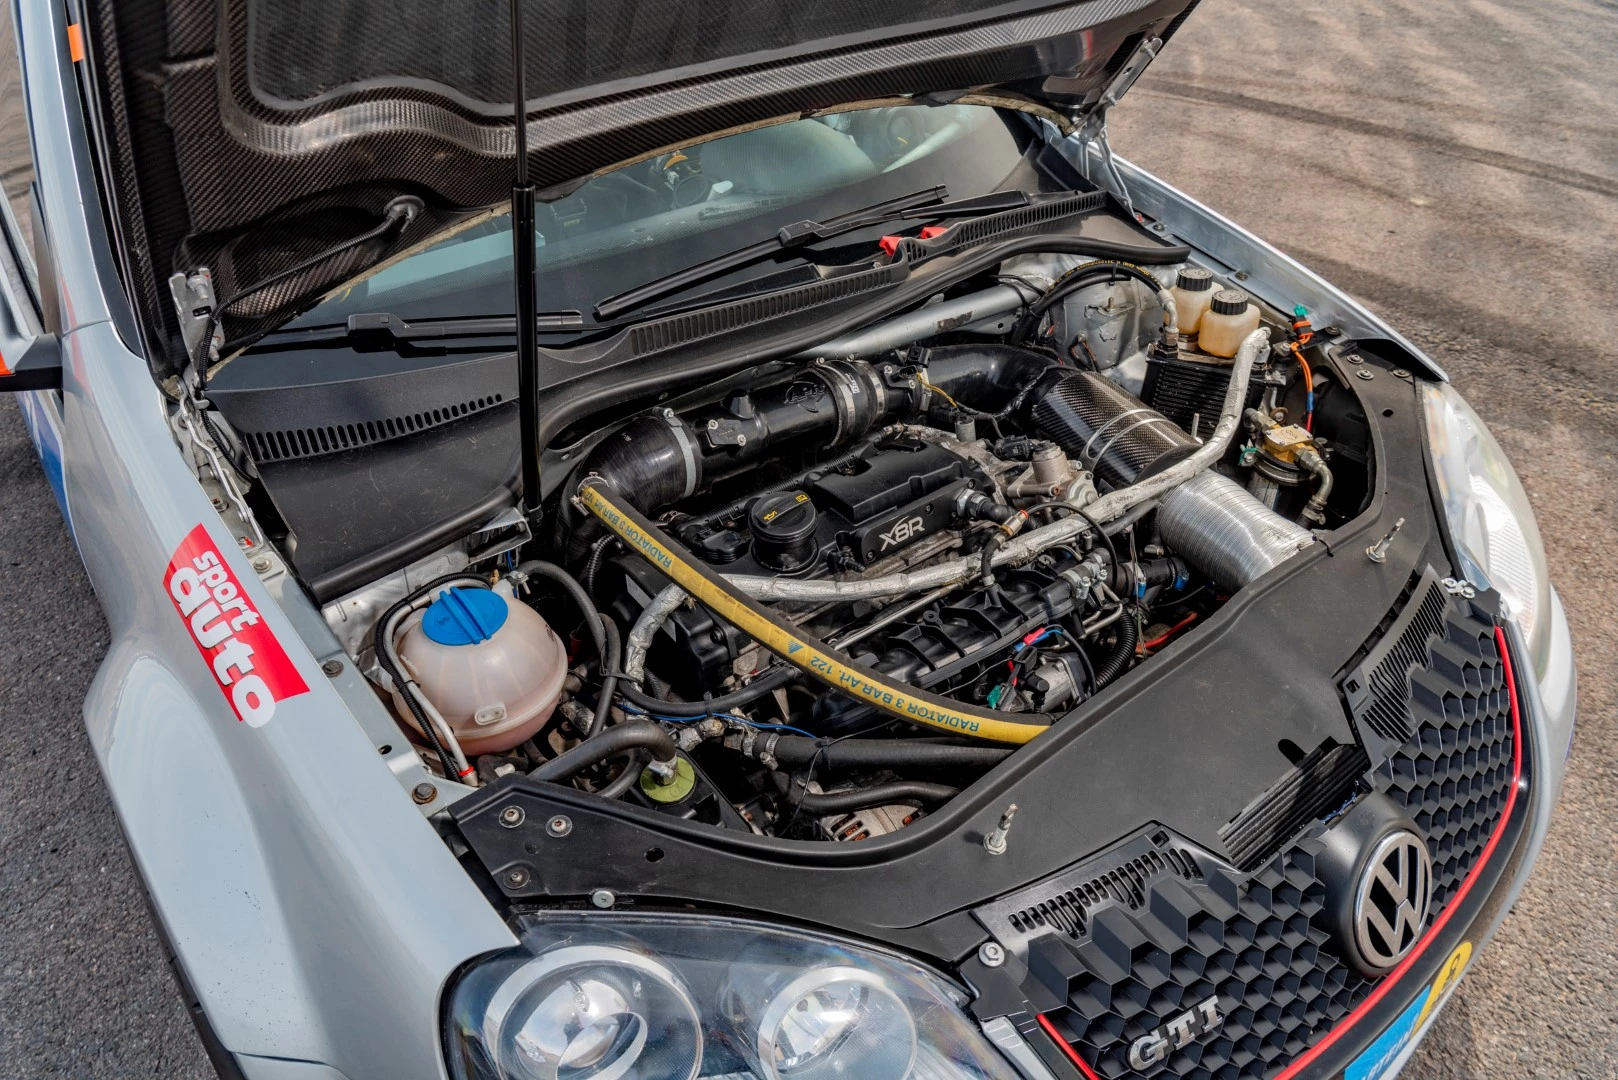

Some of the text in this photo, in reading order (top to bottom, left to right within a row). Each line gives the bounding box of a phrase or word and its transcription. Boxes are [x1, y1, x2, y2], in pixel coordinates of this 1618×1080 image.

[603, 508, 619, 525] BAR
[619, 521, 626, 530] 3
[878, 516, 926, 552] X8R
[625, 527, 672, 568] RADIATOR
[192, 550, 260, 632] sport
[170, 567, 276, 729] auto
[809, 655, 980, 732] RADIATOR 3 BAR Art. 122
[1126, 995, 1223, 1071] GTI
